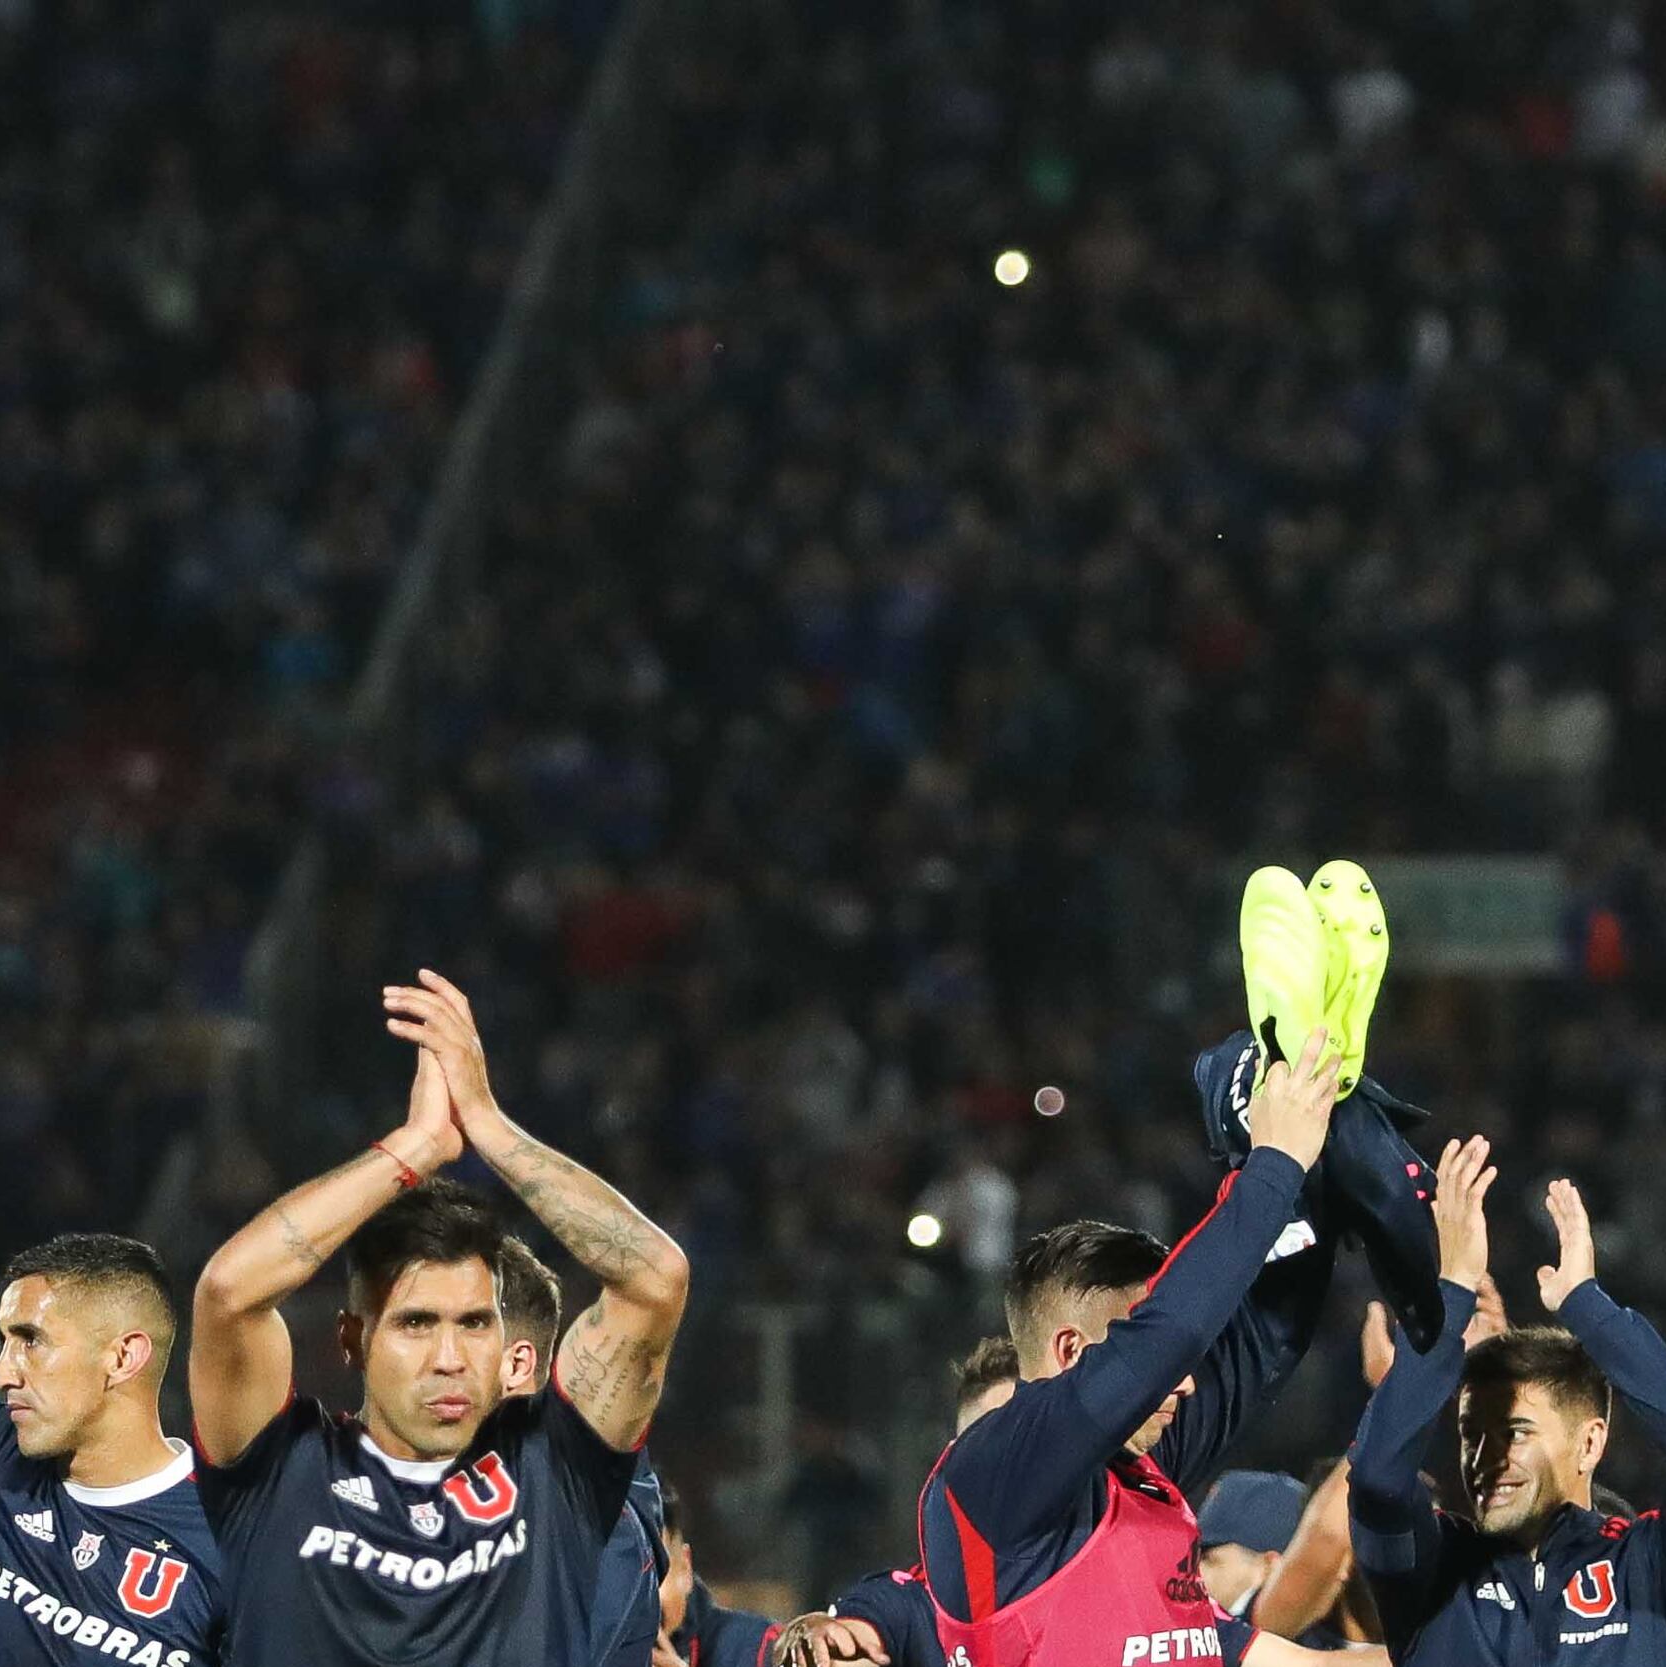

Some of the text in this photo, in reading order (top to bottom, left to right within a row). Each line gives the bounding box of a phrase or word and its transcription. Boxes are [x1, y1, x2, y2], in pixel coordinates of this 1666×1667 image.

[443, 1450, 519, 1525] U
[116, 1546, 189, 1620] U
[298, 1517, 528, 1591] PETROBRAS
[1563, 1559, 1617, 1619] U
